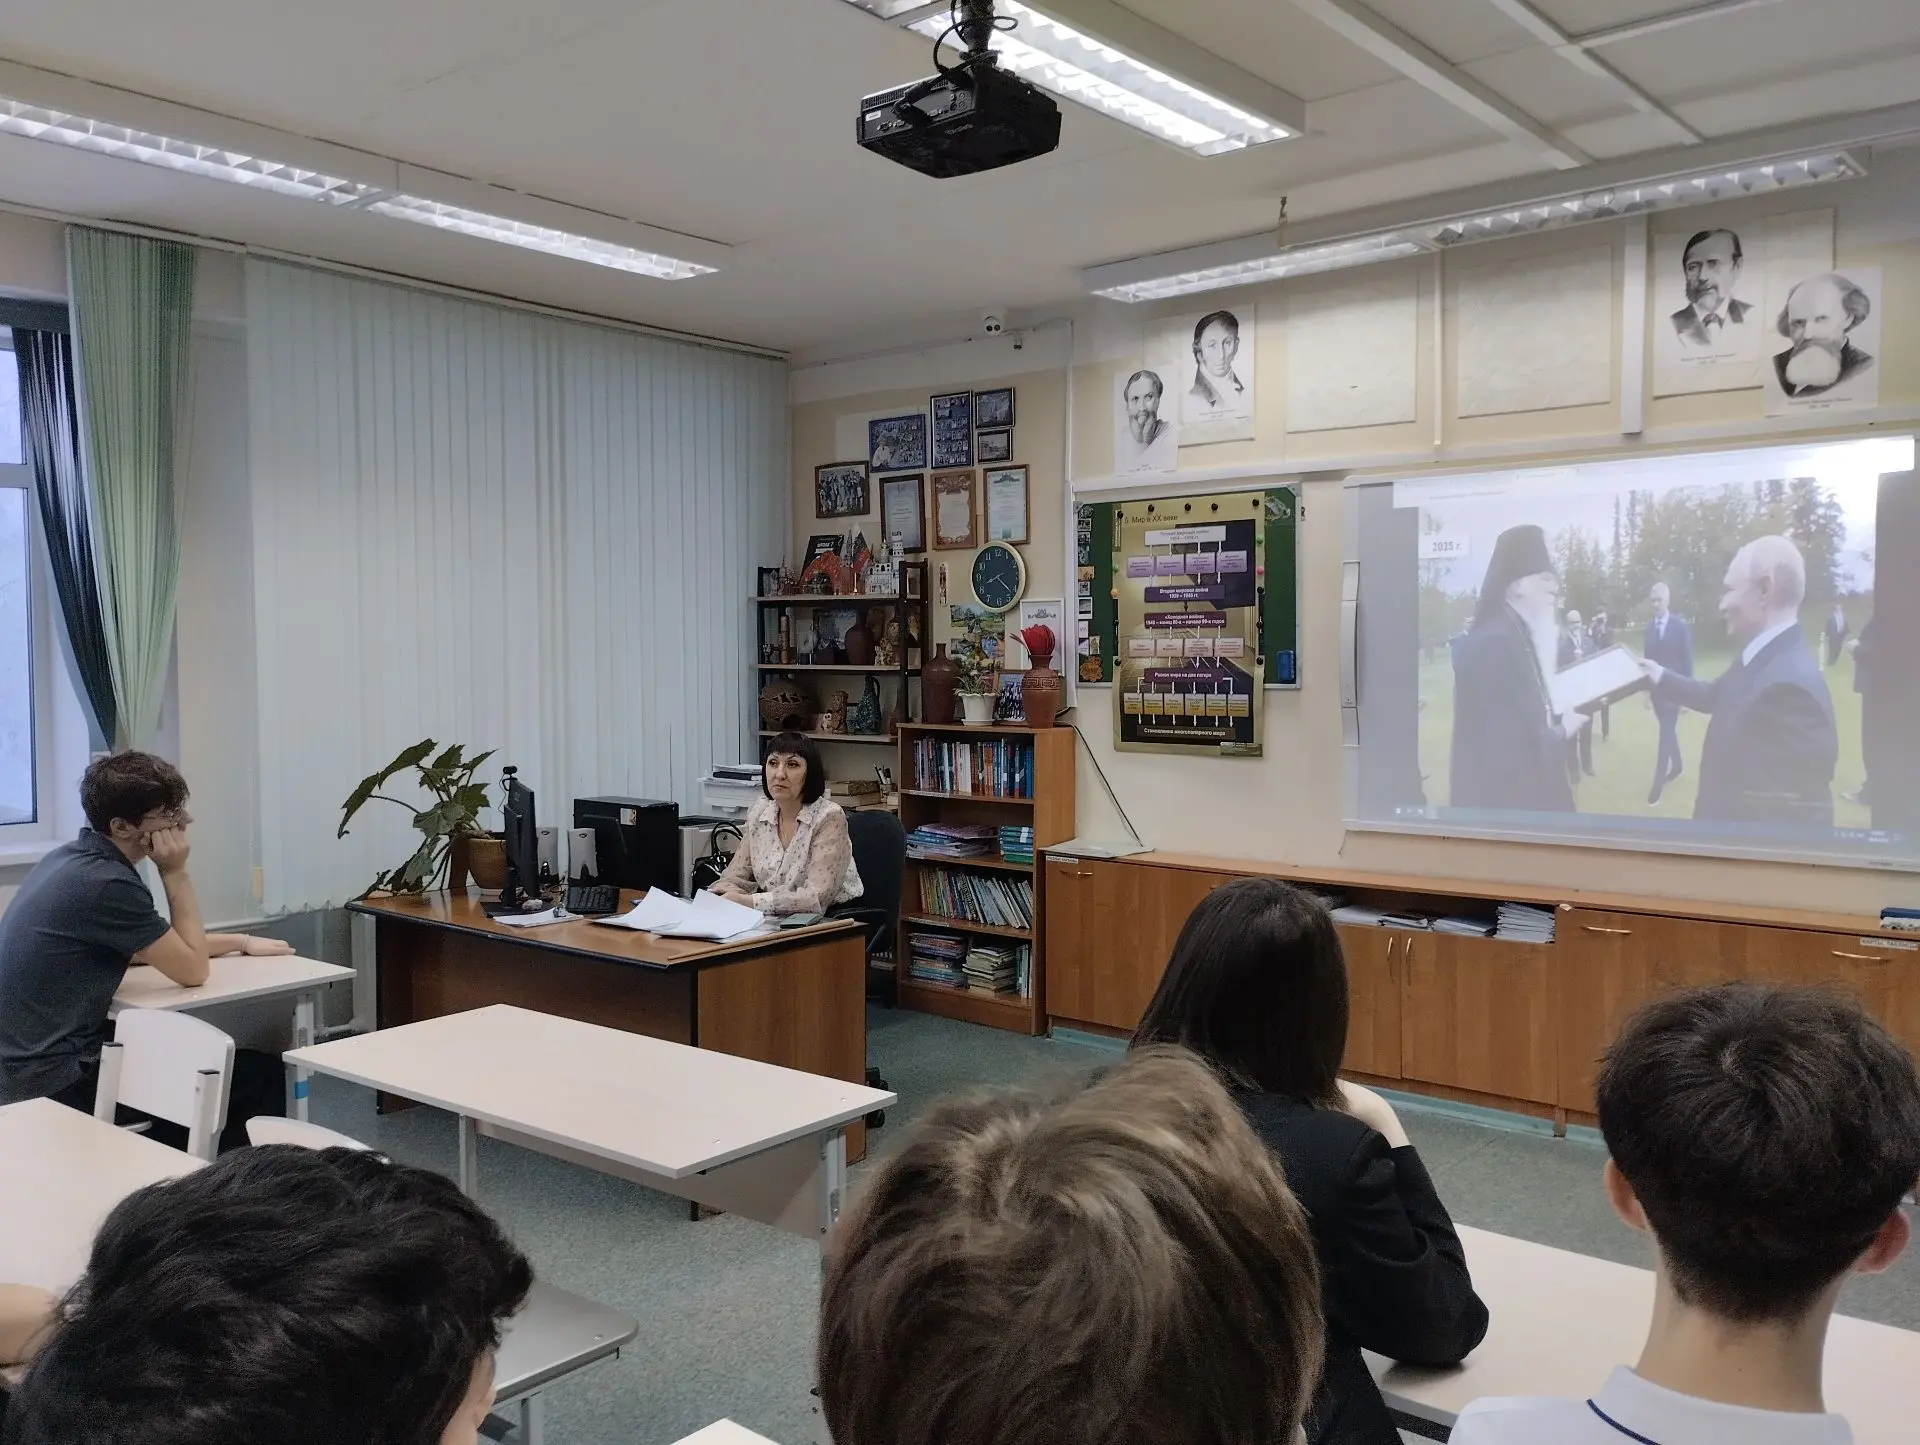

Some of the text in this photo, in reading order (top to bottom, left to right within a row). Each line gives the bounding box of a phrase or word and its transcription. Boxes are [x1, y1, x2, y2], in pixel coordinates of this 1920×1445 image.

[1131, 516, 1146, 524] Мир
[1432, 540, 1454, 552] 2025
[985, 552, 991, 560] 11
[995, 549, 1001, 557] 12
[1005, 551, 1008, 559] 1
[976, 573, 981, 582] 9
[980, 586, 984, 594] 8
[986, 594, 991, 602] 7
[996, 597, 1001, 606] 6
